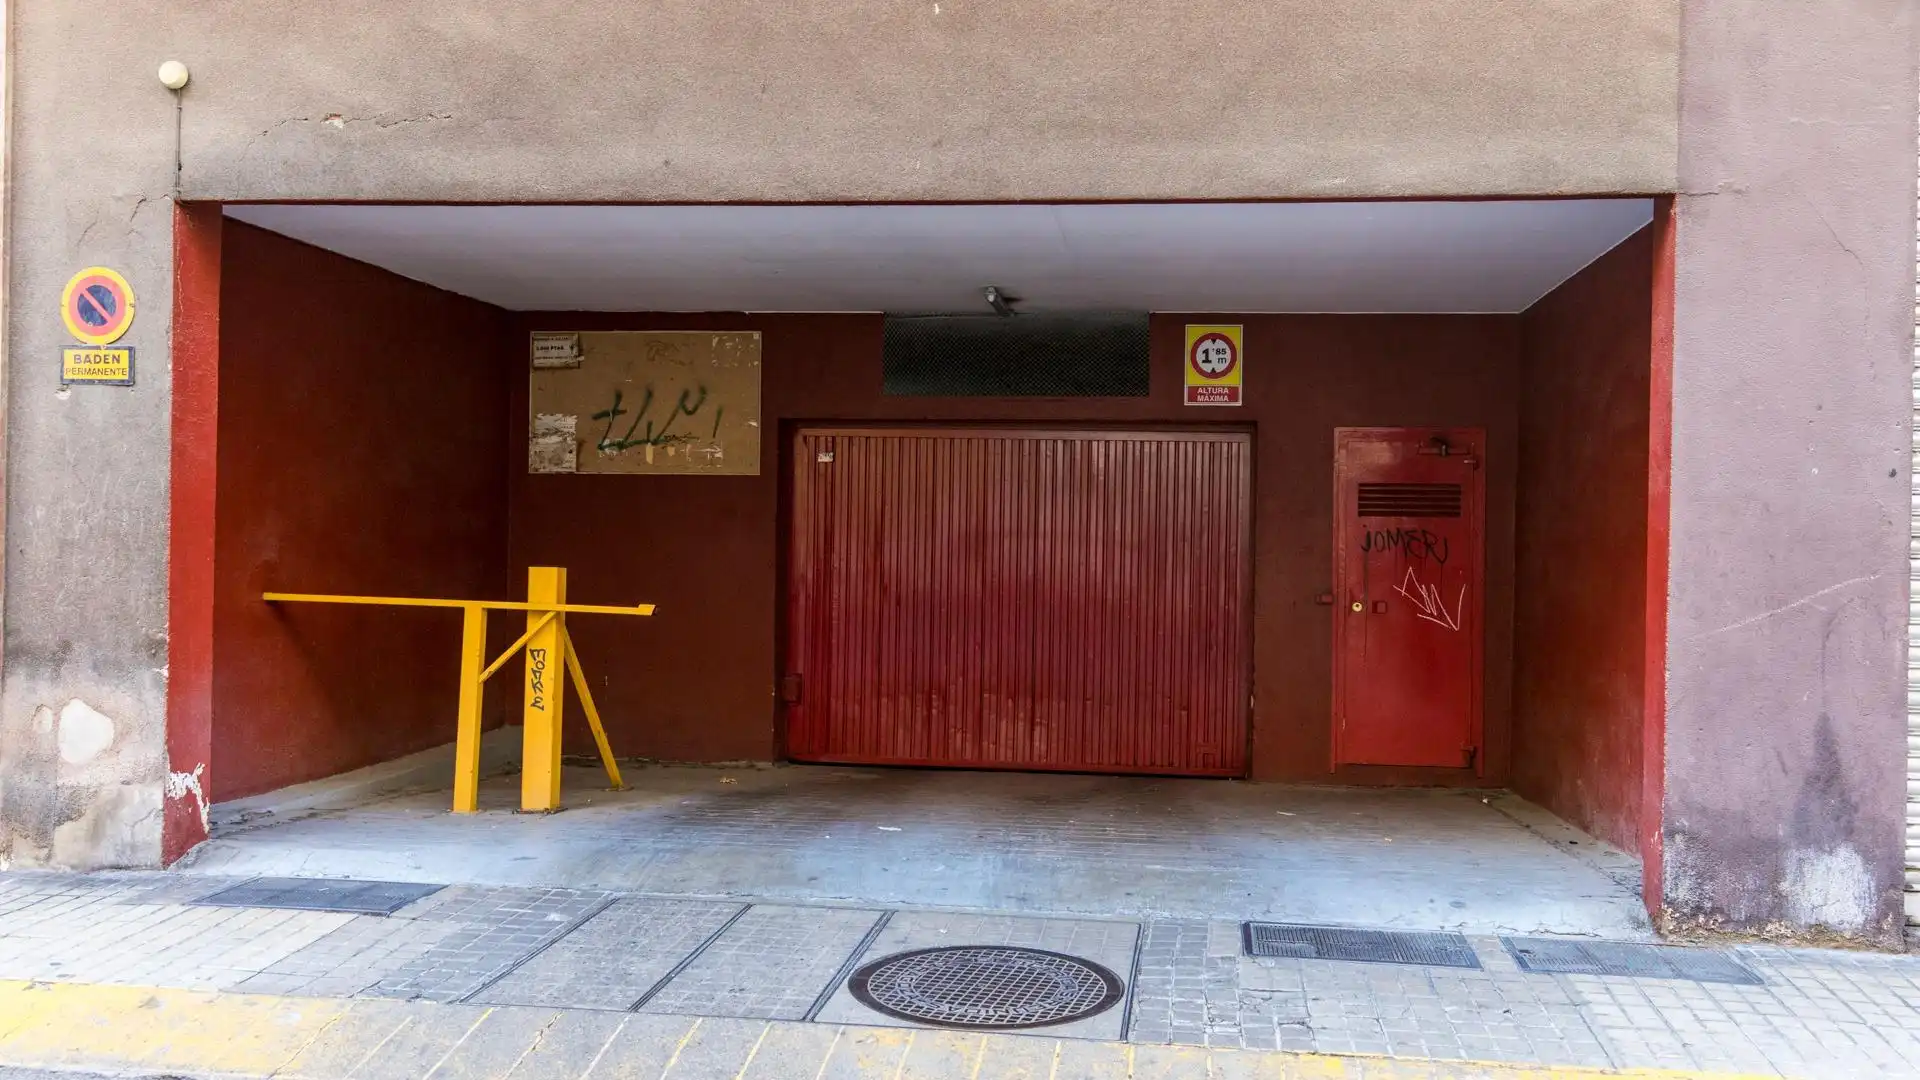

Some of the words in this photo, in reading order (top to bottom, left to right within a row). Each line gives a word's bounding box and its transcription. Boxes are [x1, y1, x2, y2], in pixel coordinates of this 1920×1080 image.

[73, 354, 121, 365] BADEN
[65, 367, 127, 377] PERMANENTE
[1196, 394, 1229, 402] MÁXIMA
